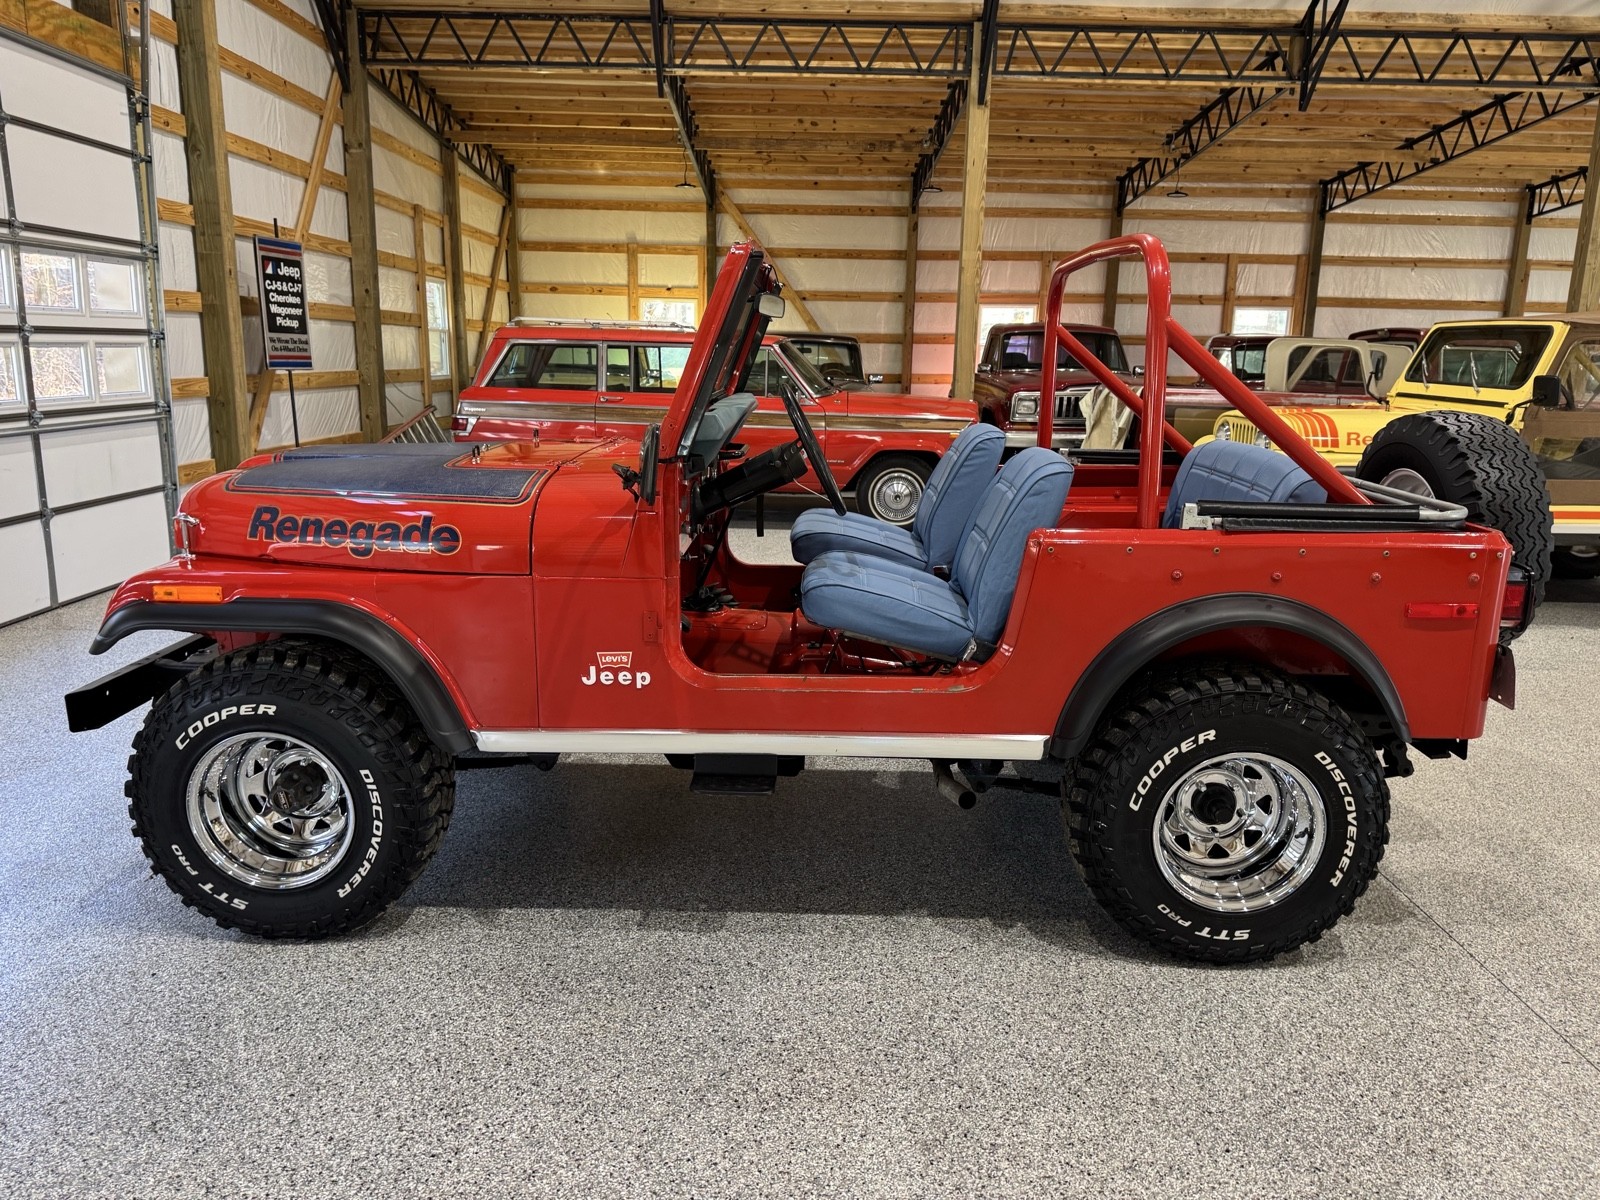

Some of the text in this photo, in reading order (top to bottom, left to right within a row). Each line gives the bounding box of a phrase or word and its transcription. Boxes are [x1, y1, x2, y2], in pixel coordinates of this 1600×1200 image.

[265, 280, 302, 293] CJ-5 & CJ-7
[277, 262, 301, 280] Jeep
[269, 292, 301, 304] Cherokee
[269, 304, 303, 316] Wagoneer
[276, 317, 299, 329] Pickup
[247, 505, 463, 559] Renegade
[582, 666, 651, 689] Jeep
[175, 703, 277, 752] COOPER
[1129, 729, 1217, 812] COOPER
[336, 769, 385, 900] DISCOVERER
[1314, 751, 1359, 888] DISCOVERER
[170, 843, 250, 911] STT PRO
[1157, 903, 1252, 942] STT PRO
